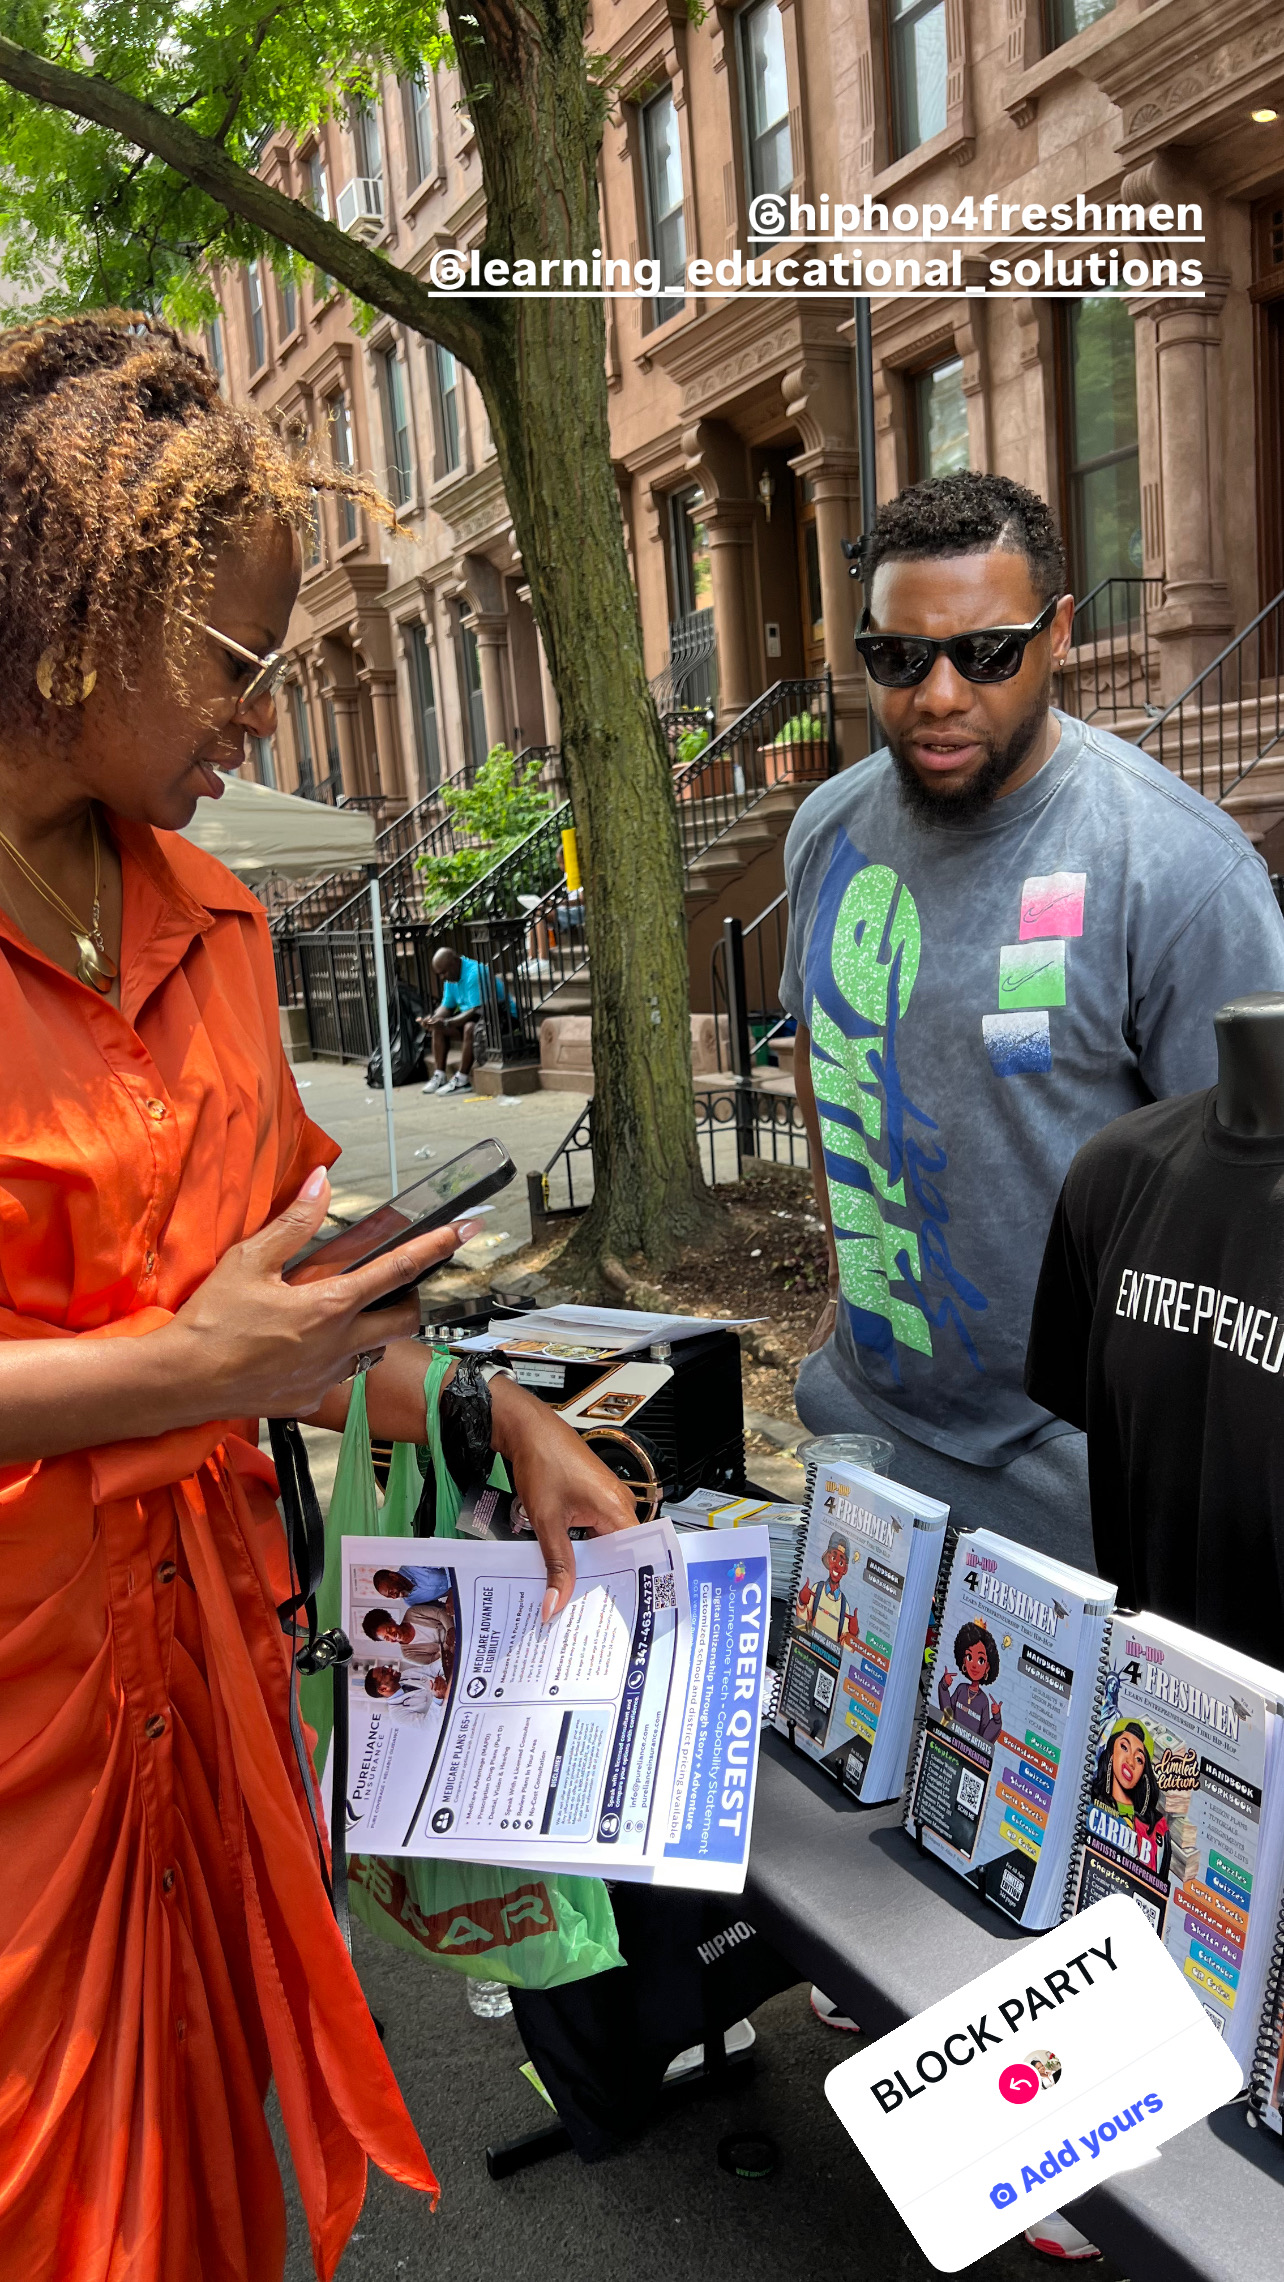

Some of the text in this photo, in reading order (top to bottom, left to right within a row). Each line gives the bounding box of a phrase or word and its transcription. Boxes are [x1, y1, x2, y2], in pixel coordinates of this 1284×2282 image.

[824, 1496, 836, 1514] 4
[836, 1497, 895, 1548] FRESHMEN
[966, 1552, 997, 1573] HIP-HOP
[635, 1573, 652, 1666] 347-463-4737
[711, 1587, 721, 1621] Digital
[964, 1571, 1058, 1638] 4 FRESHMEN
[473, 1585, 493, 1673] MEDICARE ADVANTAGE
[500, 1657, 511, 1683] Medicare
[515, 1591, 525, 1616] Required
[555, 1655, 566, 1680] Medicare
[561, 1628, 572, 1654] Eligibility
[567, 1604, 577, 1627] Required
[483, 1630, 500, 1672] ELIGIBILITY
[705, 1623, 720, 1681] Citizenship
[1026, 1650, 1066, 1678] HANDBOOK
[1125, 1640, 1165, 1665] HIP-HOP
[1024, 1663, 1065, 1692] WORKBOOK
[668, 1584, 709, 1839] Customized school and district pricing available
[699, 1684, 714, 1728] Through
[717, 1582, 762, 1836] CYBER QUEST
[1123, 1660, 1240, 1742] 4 FRESHMEN
[619, 1710, 630, 1741] consultant
[698, 1584, 737, 1854] JourneyOne Tech Capability Statement
[1124, 1688, 1142, 1702] LEARN
[1144, 1697, 1195, 1730] ENTREPRENEURSHIP
[1213, 1735, 1237, 1754] HIP-HOP
[352, 1712, 381, 1800] PURELIANCE
[441, 1710, 472, 1803] MEDICARE PLANS (65+)
[489, 1748, 499, 1765] Plans
[526, 1753, 535, 1768] Your
[530, 1738, 538, 1753] Area
[615, 1742, 624, 1767] licensed
[622, 1742, 631, 1765] options
[639, 1710, 662, 1807] purelianceinsurance.com
[694, 1730, 707, 1759] Story
[929, 1740, 959, 1766] Chapters
[971, 1735, 991, 1755] ARTISTS
[1003, 1735, 1053, 1774] Brainstorm Pad
[1030, 1736, 1056, 1758] Puzzles
[363, 1734, 384, 1800] INSURANCE
[485, 1765, 494, 1781] Drug
[493, 1777, 503, 1796] Vision
[499, 1745, 510, 1770] Hearing
[504, 1716, 532, 1816] Speak With Licensed Consultant
[550, 1754, 562, 1788] DISCLAIMER
[611, 1772, 619, 1787] with
[619, 1766, 627, 1779] your
[629, 1723, 650, 1808] info@pureliance.com
[1023, 1766, 1050, 1789] Quizzes
[1205, 1763, 1254, 1798] HANDBOOK
[465, 1790, 477, 1819] Medicare
[473, 1757, 485, 1789] Advantage
[521, 1775, 530, 1793] Plans
[528, 1750, 547, 1816] No-Cost Consultation
[608, 1788, 616, 1807] Speak
[614, 1780, 624, 1807] compare
[1034, 1792, 1047, 1806] Pad
[1203, 1779, 1253, 1814] WORKBOOK
[476, 1782, 490, 1819] Prescription
[516, 1793, 526, 1816] Review
[684, 1771, 701, 1830] Adventure
[957, 1804, 975, 1821] SCAN ME
[1093, 1798, 1120, 1818] FEATURING
[1208, 1802, 1248, 1831] LESSON PLANS
[1088, 1807, 1153, 1864] CARDI B
[1207, 1823, 1245, 1851] ASSIGNMENTS
[1208, 1813, 1238, 1836] TUTORIALS
[1086, 1834, 1091, 1844] 4
[1091, 1836, 1116, 1860] ARTISTS
[1121, 1855, 1167, 1894] ENTREPRENEURS
[1206, 1833, 1248, 1864] KEYWORD LISTS
[1090, 1859, 1130, 1889] Chapters
[1216, 1859, 1247, 1885] Puzzles
[1190, 1883, 1244, 1925] Lyric Sheets
[1213, 1876, 1245, 1903] Quizzes
[1177, 1893, 1241, 1943] Brainstorm Pad
[1190, 1922, 1237, 1961] Sketch Pad
[1198, 1951, 1234, 1980] Calendar
[1192, 1967, 1230, 2000] QR Codes
